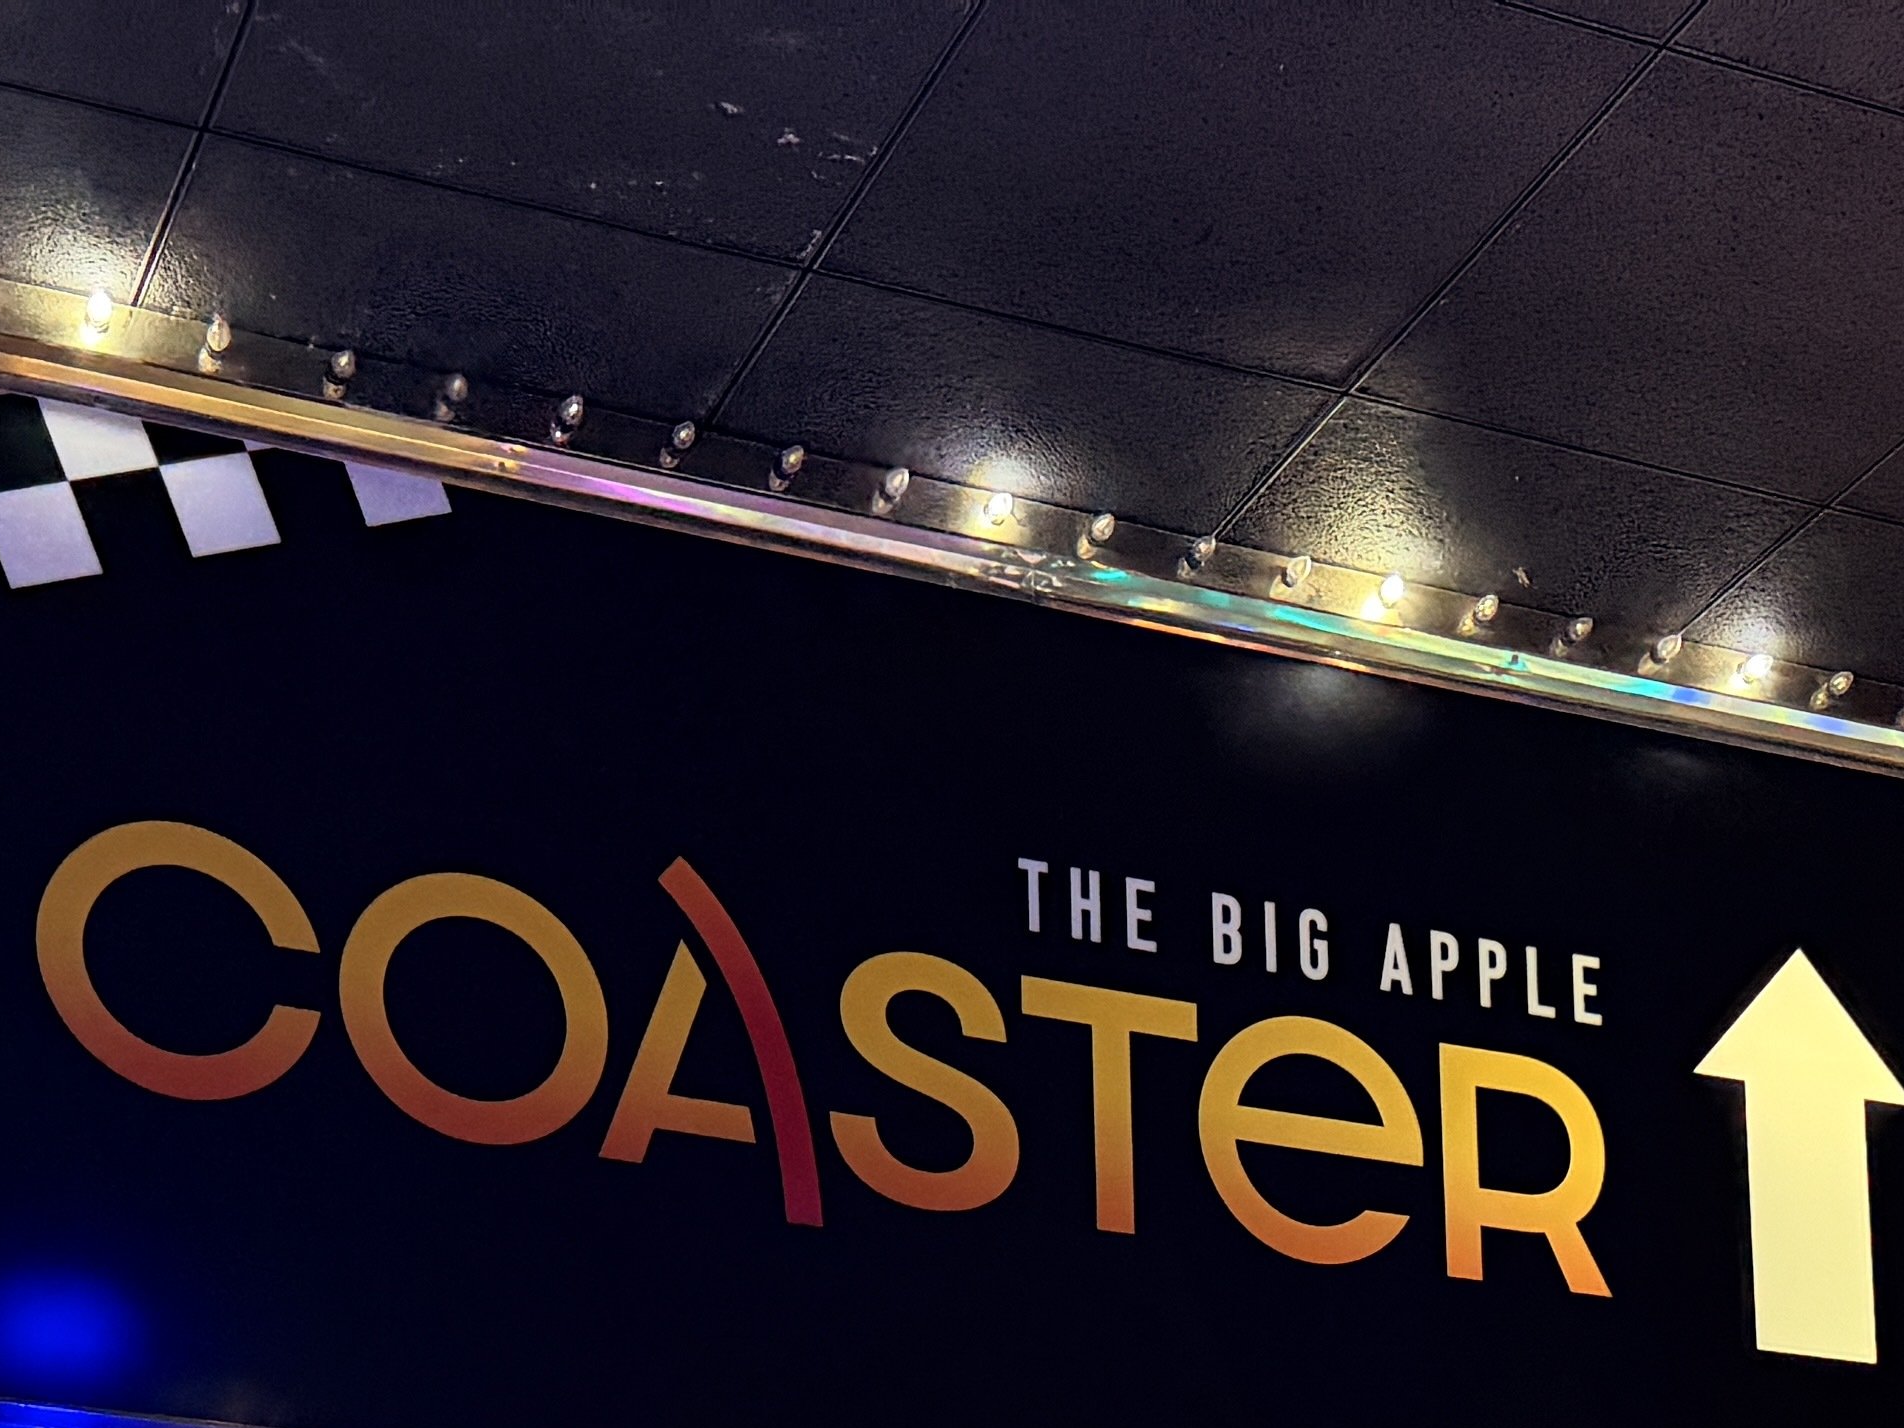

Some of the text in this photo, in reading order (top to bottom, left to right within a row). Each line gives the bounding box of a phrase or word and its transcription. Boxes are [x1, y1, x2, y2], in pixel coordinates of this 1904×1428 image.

[1017, 857, 1604, 1026] THE BIG APPLE
